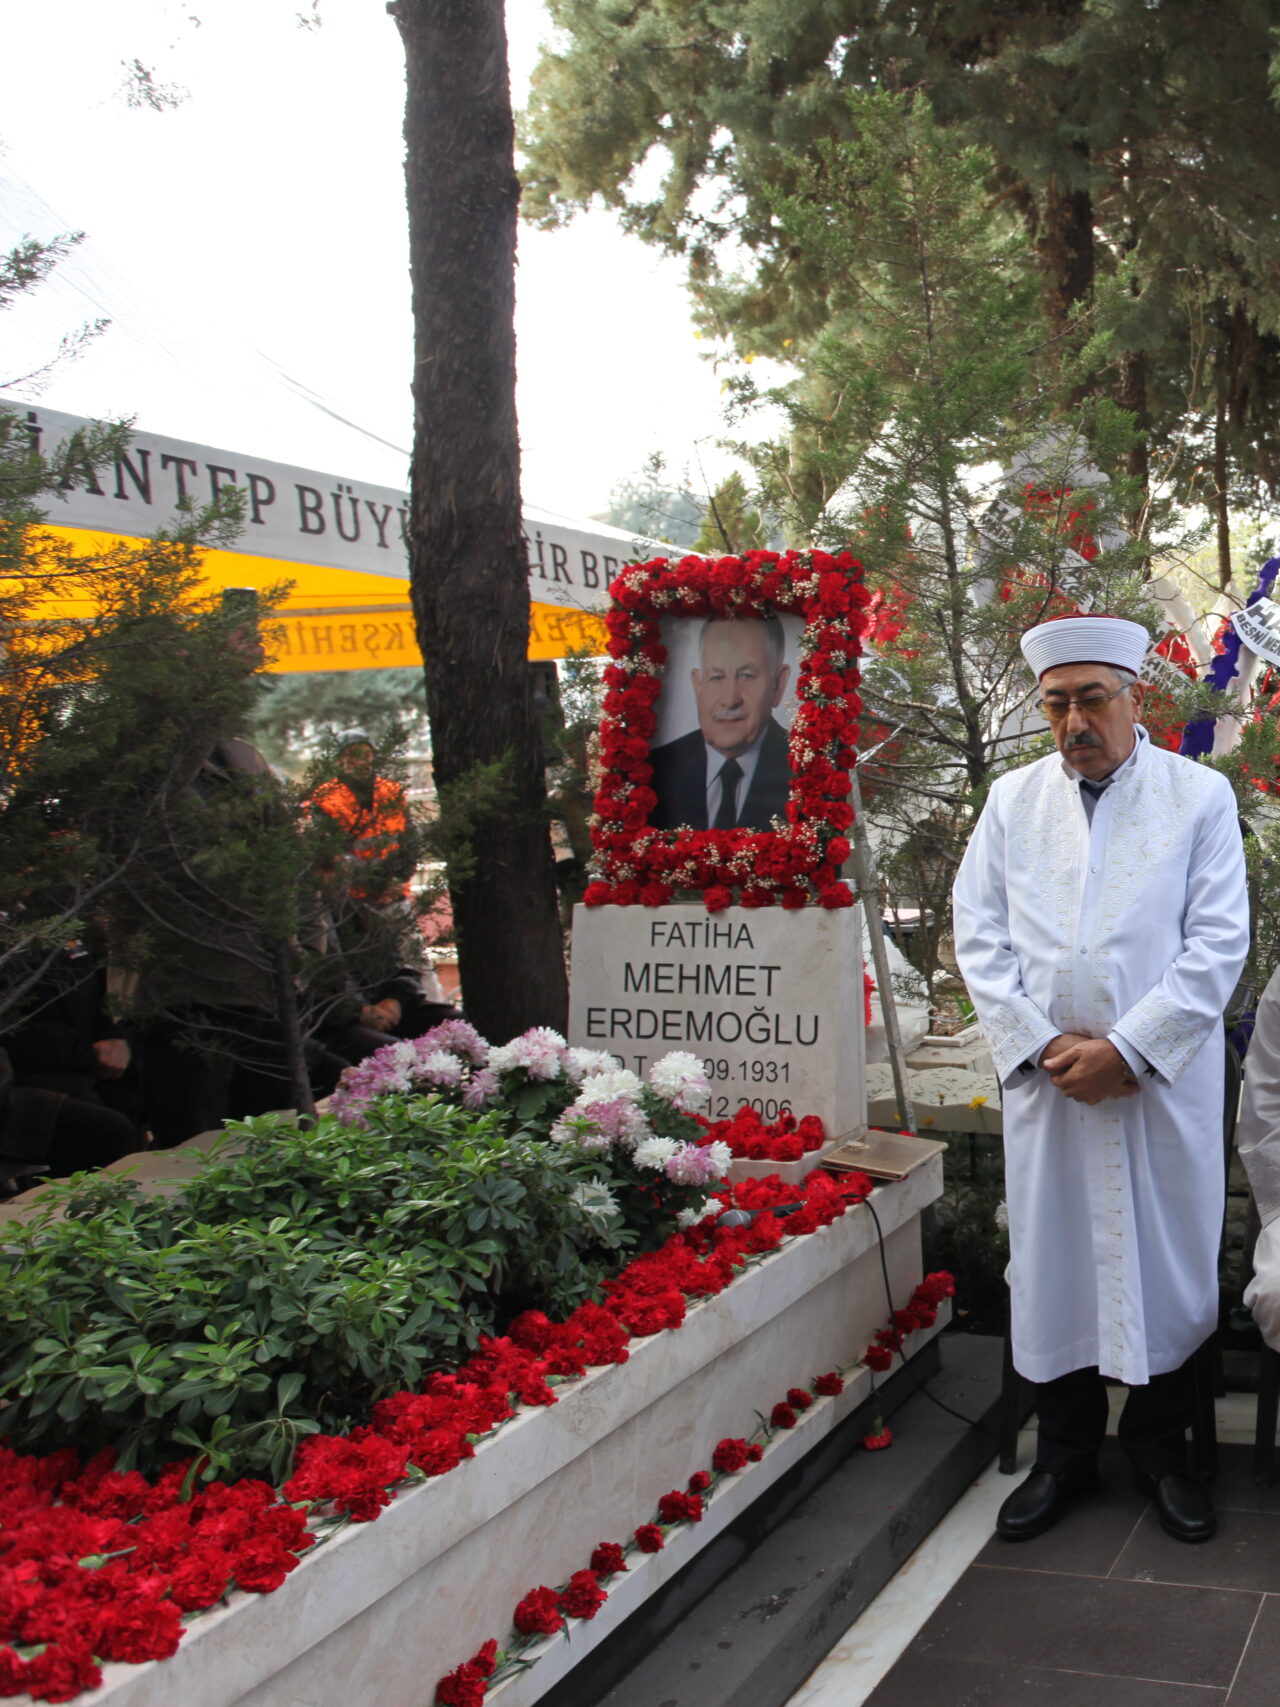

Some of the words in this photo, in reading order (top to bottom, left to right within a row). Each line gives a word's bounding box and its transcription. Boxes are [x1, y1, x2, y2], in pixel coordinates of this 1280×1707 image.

[1236, 613, 1269, 645] BESNİ
[651, 917, 754, 949] FATİHA
[624, 962, 781, 996] MEHMET
[586, 1006, 819, 1046] ERDEMOĞLU
